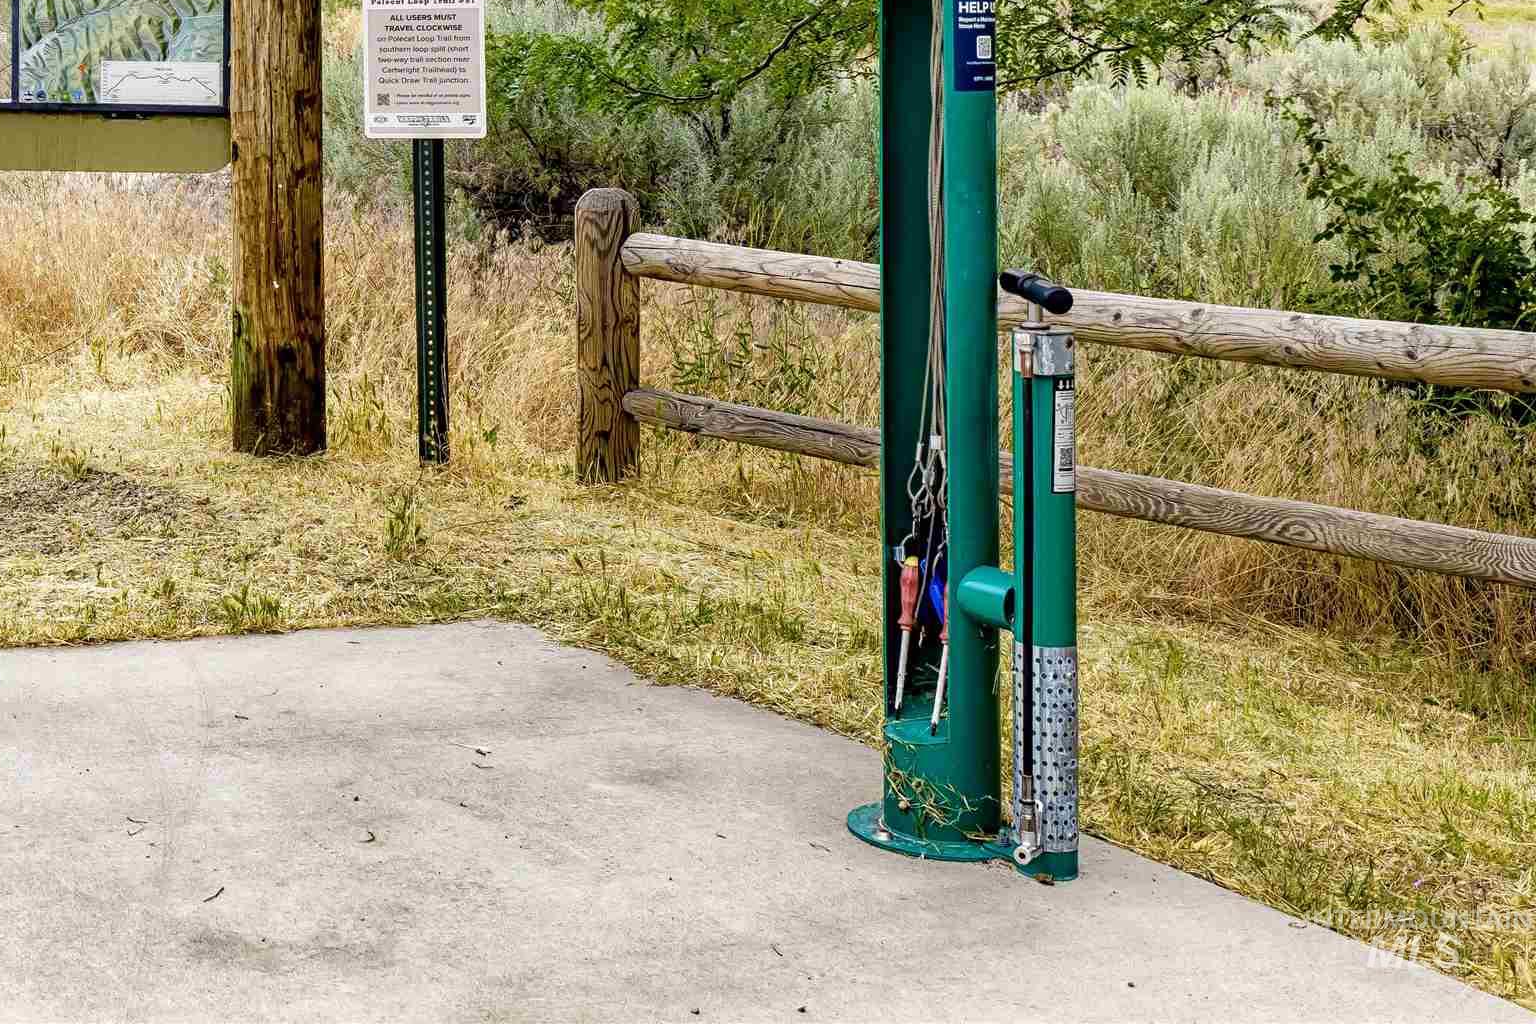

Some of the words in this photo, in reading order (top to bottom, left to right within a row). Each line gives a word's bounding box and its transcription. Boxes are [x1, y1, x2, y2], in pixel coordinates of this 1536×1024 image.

[959, 1, 989, 13] HELP
[416, 35, 434, 43] Loop
[412, 46, 429, 54] loop
[377, 57, 409, 65] two-way
[382, 66, 420, 75] Cartwright
